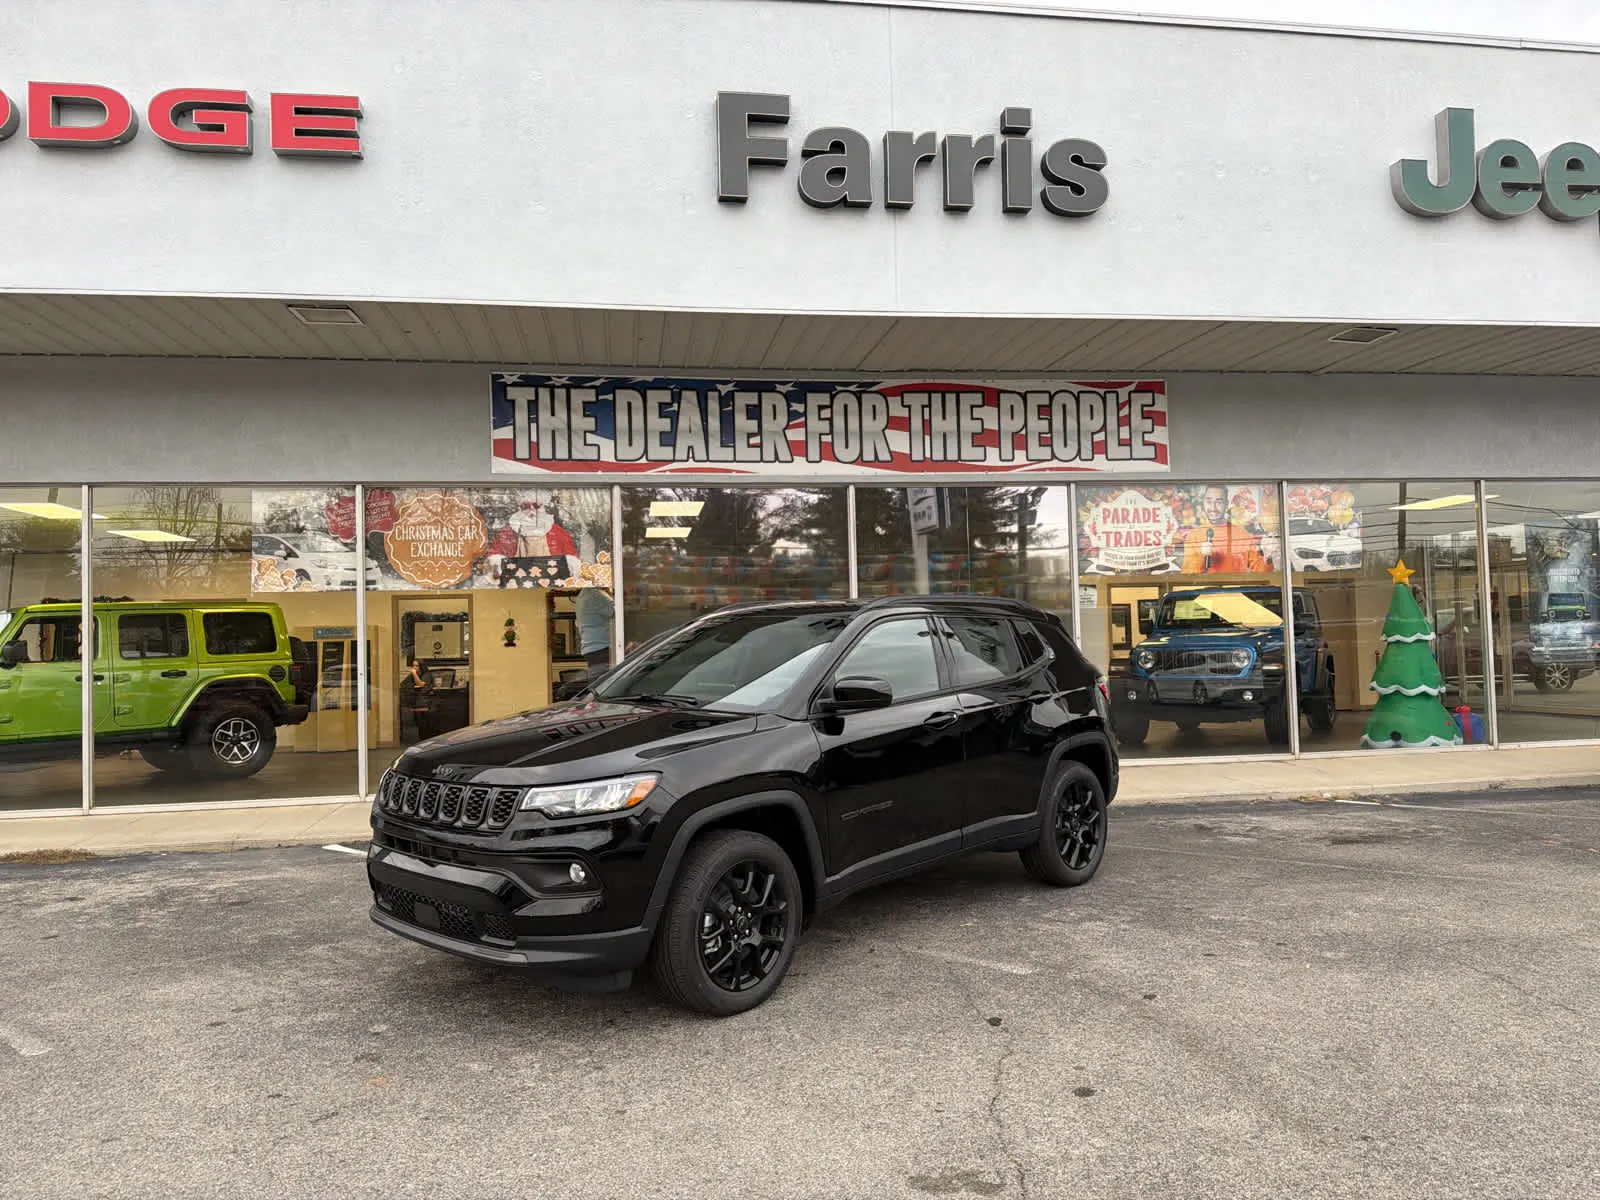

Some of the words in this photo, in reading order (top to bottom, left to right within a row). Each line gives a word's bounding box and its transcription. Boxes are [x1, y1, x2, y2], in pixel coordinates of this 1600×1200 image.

[0, 80, 364, 160] DGE
[716, 91, 1109, 217] Farris
[1389, 107, 1600, 224] Jee
[505, 385, 601, 461] THE
[613, 387, 794, 463] DEALER
[806, 391, 893, 464] FOR
[901, 390, 986, 462] THE
[998, 390, 1157, 462] PEOPLE
[395, 525, 455, 541] CHRISTMAS
[457, 524, 480, 541] CAR
[1102, 507, 1161, 524] PARADE
[1102, 530, 1162, 547] TRADES
[410, 541, 465, 558] EXCHANGE
